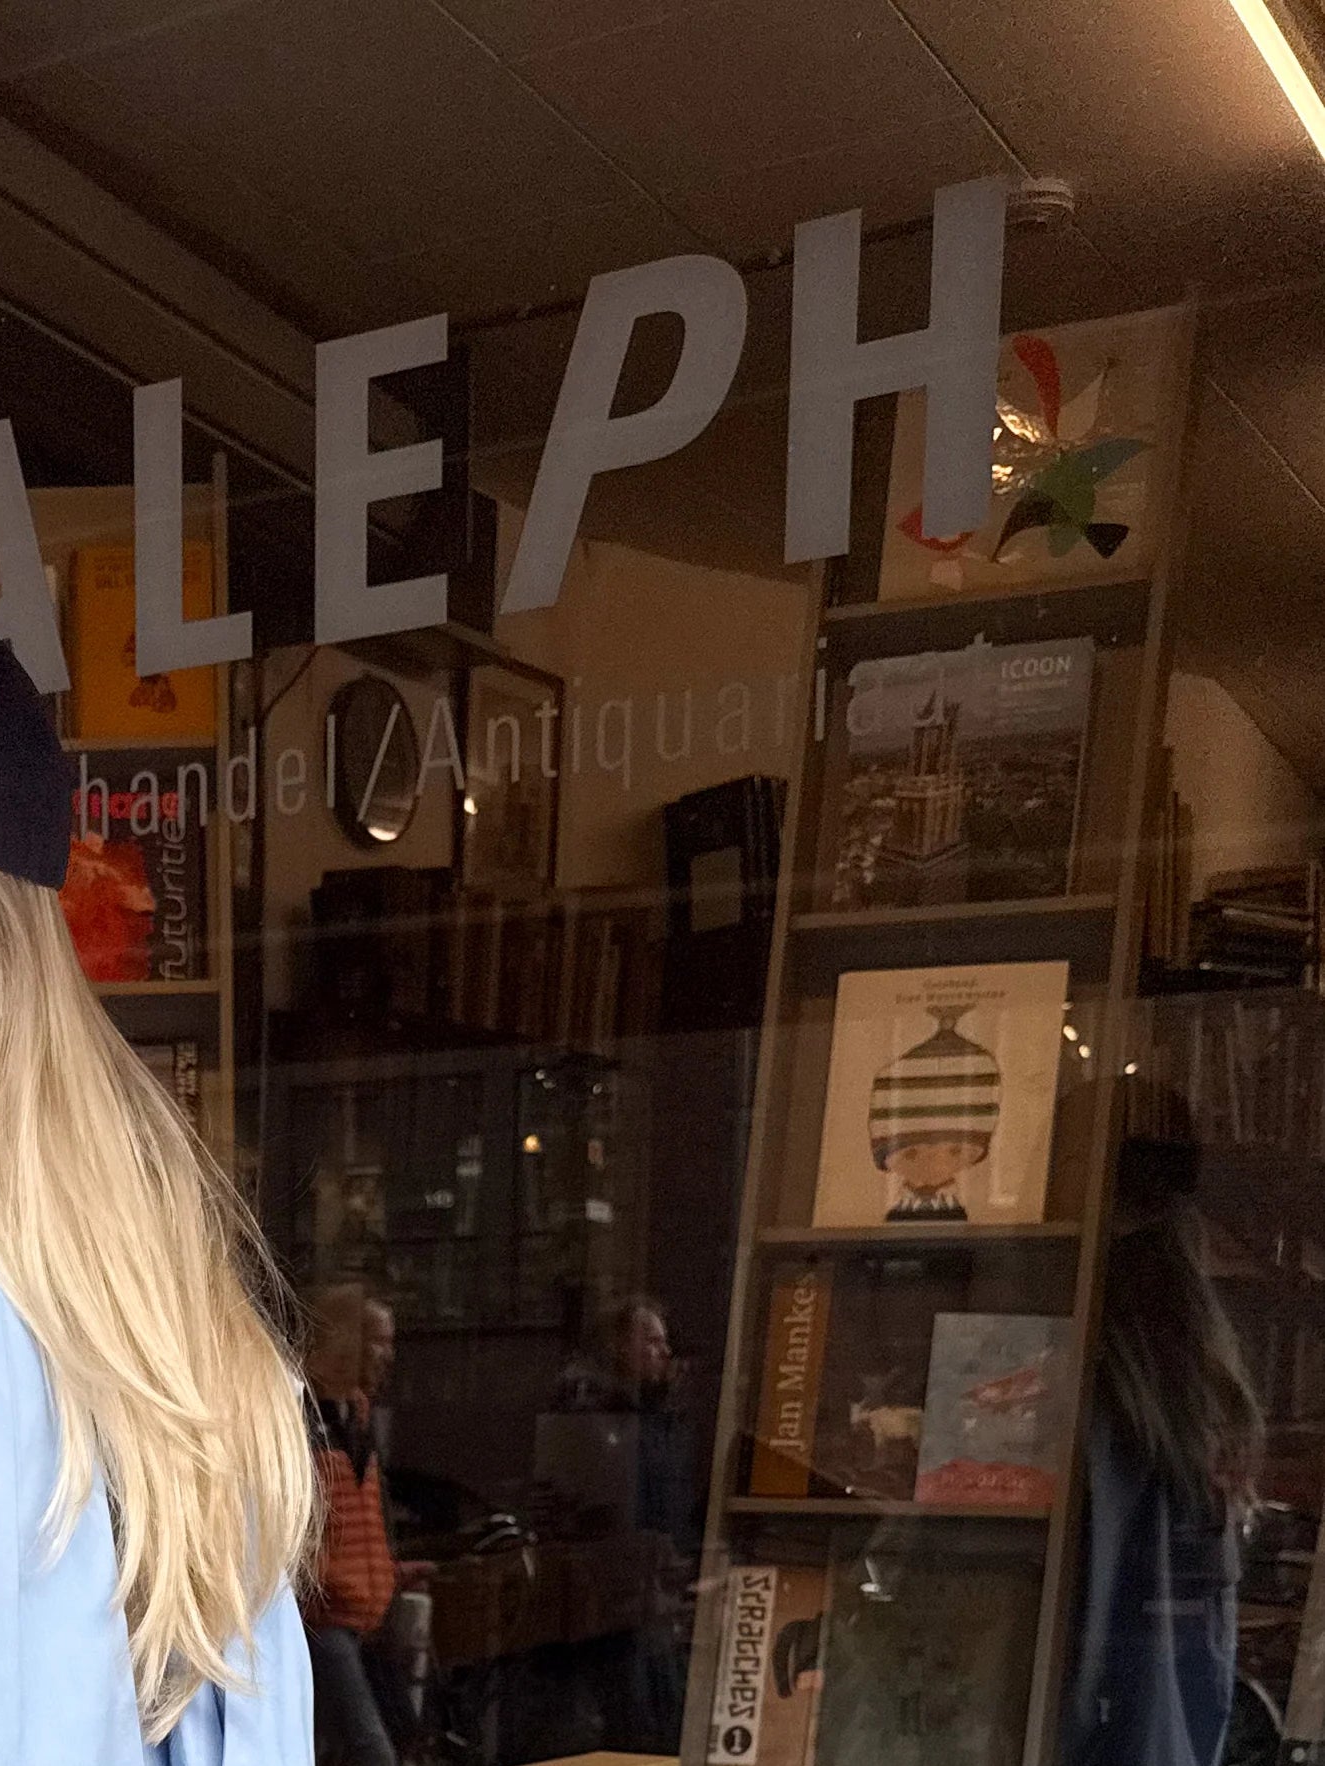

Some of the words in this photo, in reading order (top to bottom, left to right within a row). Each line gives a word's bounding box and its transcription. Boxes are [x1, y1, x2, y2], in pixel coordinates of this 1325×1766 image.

[1001, 655, 1072, 681] ICOON
[774, 1272, 819, 1392] Mankes
[768, 1402, 807, 1451] Jan
